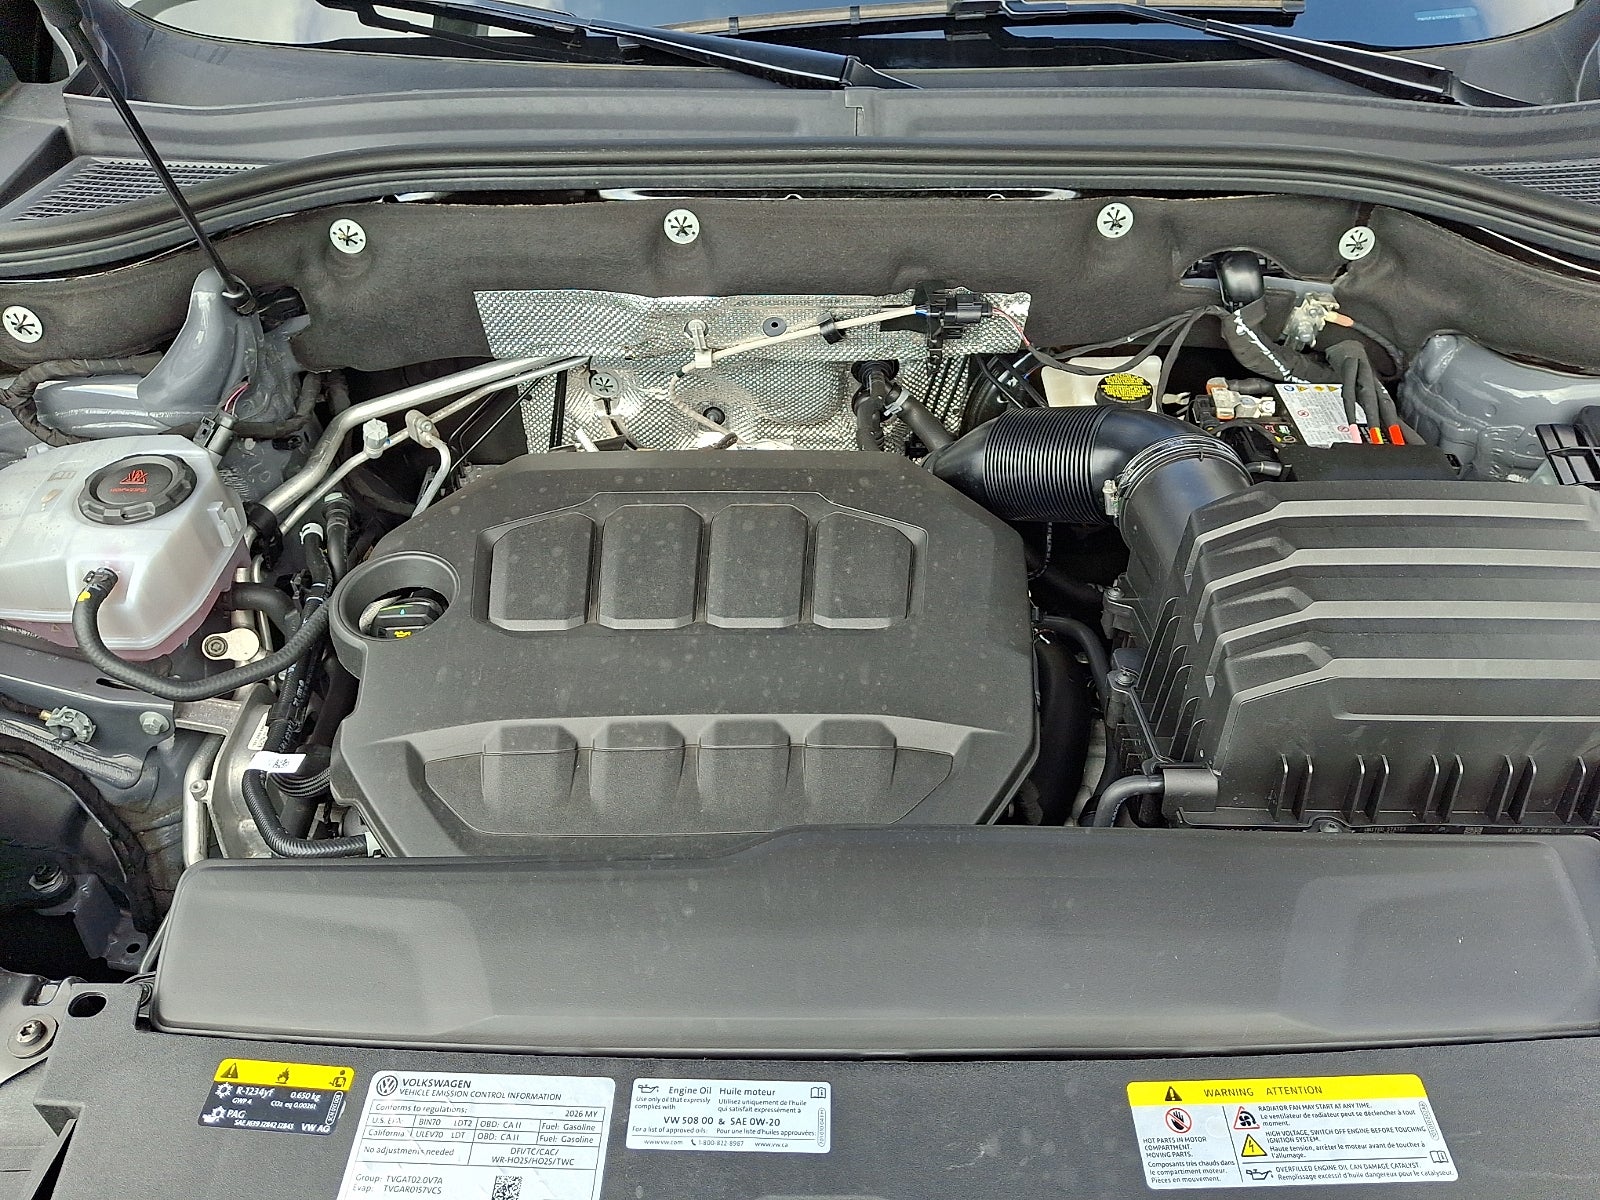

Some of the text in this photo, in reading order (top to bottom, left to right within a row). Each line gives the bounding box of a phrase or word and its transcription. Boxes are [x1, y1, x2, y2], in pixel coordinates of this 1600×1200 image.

[402, 1078, 471, 1088] VOLKSWAGEN
[236, 1086, 275, 1098] R-1234yf
[399, 1088, 562, 1100] VEHICLE EMISSION CONTROL INFORMATION
[669, 1087, 697, 1096] Engine
[1204, 1086, 1323, 1097] WARNING ATTENTION
[290, 1091, 321, 1102] 0.650 kg
[375, 1103, 411, 1112] Conforms
[226, 1109, 246, 1118] PAG
[419, 1118, 441, 1126] BIN70
[664, 1116, 680, 1124] VW
[682, 1116, 699, 1124] 508
[701, 1117, 714, 1125] 00
[730, 1117, 747, 1125] SAE
[749, 1117, 781, 1126] 0W-20
[301, 1123, 330, 1132] VW AG
[563, 1123, 596, 1131] Gasoline
[561, 1135, 594, 1143] Gasoline
[426, 1148, 455, 1156] needed
